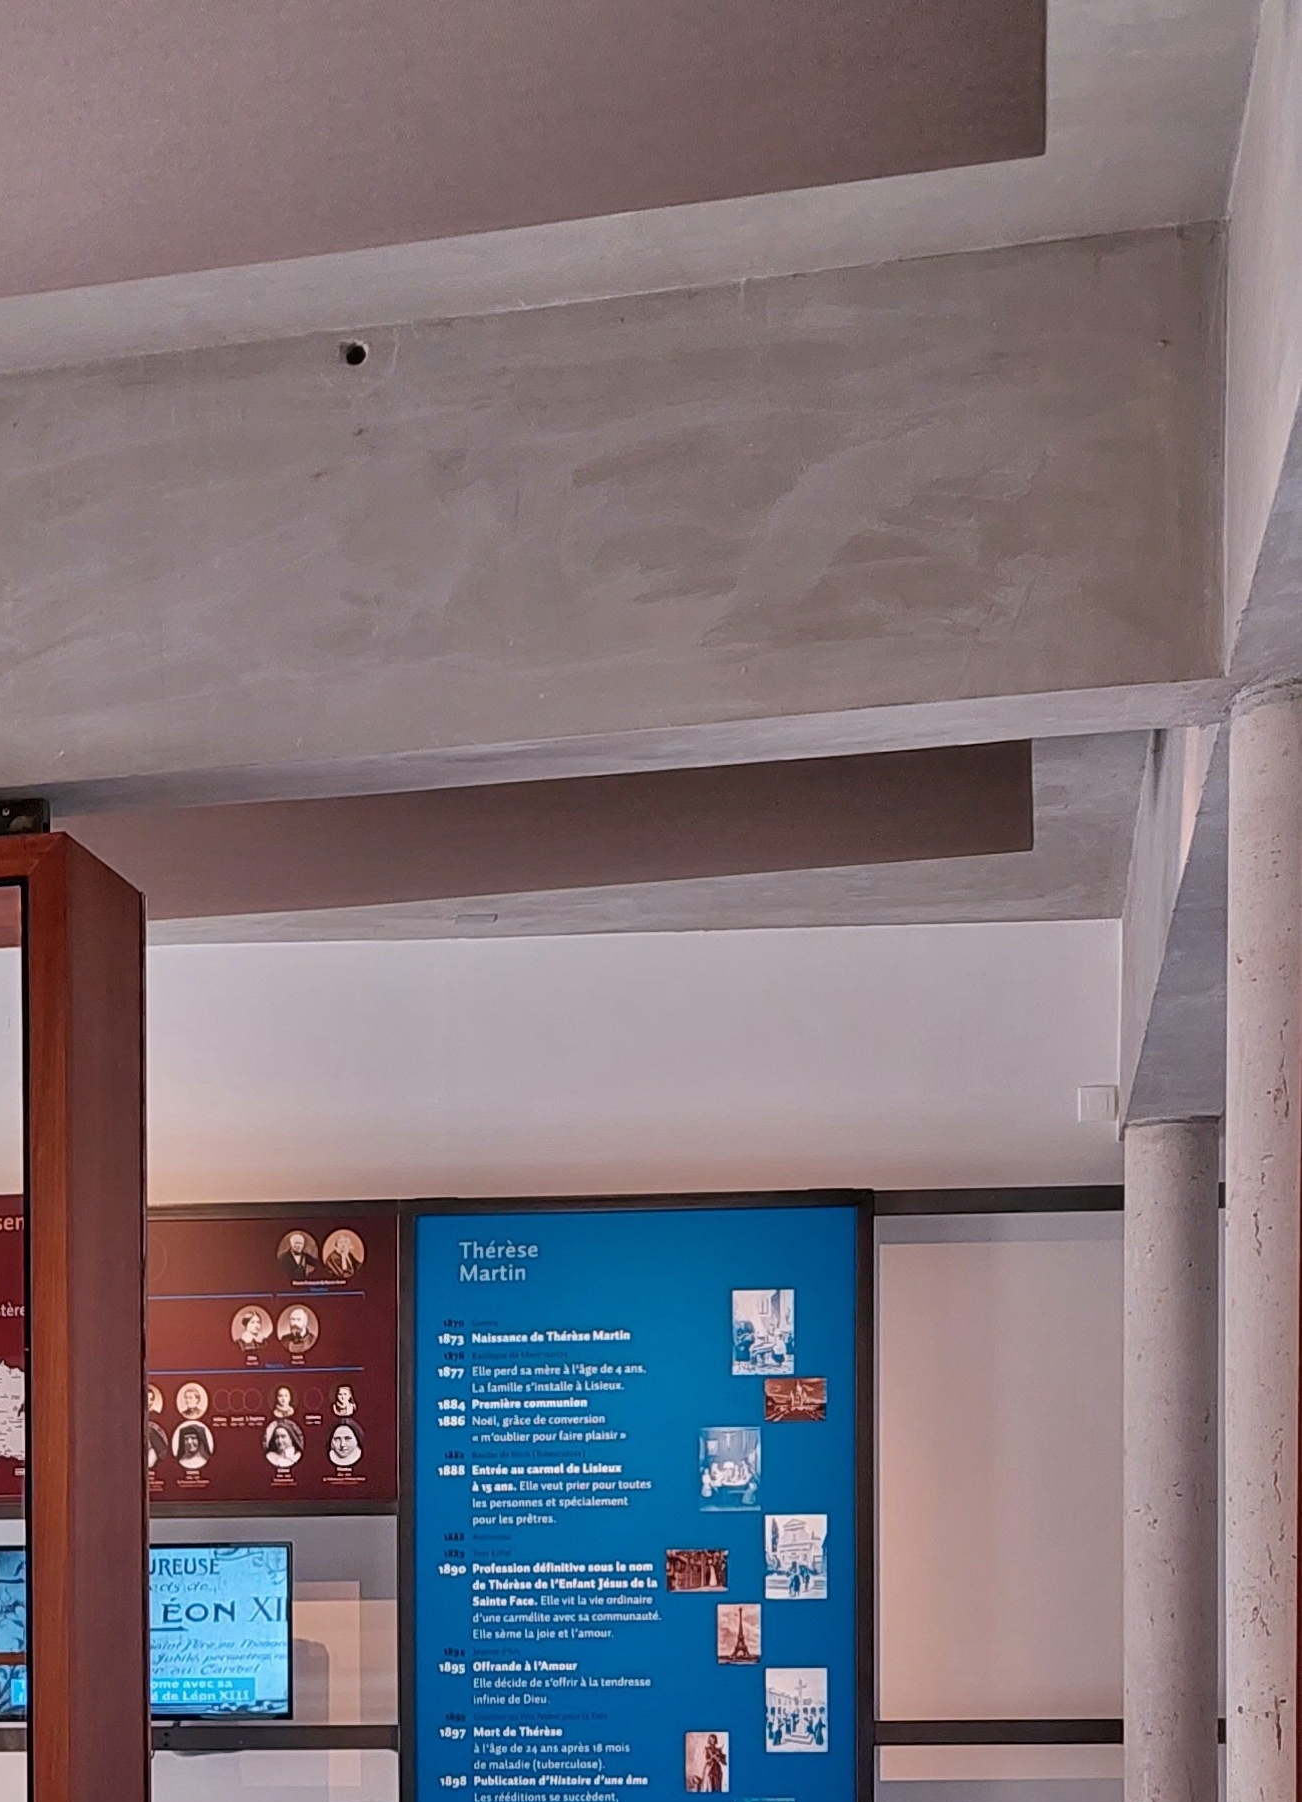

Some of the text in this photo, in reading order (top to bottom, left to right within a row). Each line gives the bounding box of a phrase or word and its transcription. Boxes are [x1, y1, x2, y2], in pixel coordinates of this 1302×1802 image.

[458, 1238, 538, 1259] Thérèse
[459, 1263, 526, 1282] Martin
[437, 1329, 630, 1346] 1873 Naissance de Thérèse Martin
[437, 1365, 464, 1379] 1877
[471, 1365, 491, 1377] Elle
[493, 1364, 518, 1378] perd
[519, 1366, 532, 1375] sa
[533, 1363, 561, 1375] mère
[562, 1363, 570, 1375] à
[599, 1362, 613, 1374] de
[614, 1365, 622, 1375] 4
[623, 1364, 647, 1374] ans.
[437, 1396, 588, 1412] 1884 Première communion
[249, 1596, 287, 1622] XI
[438, 1661, 465, 1674] 1895
[472, 1660, 522, 1672] Offrande
[523, 1660, 532, 1671] à
